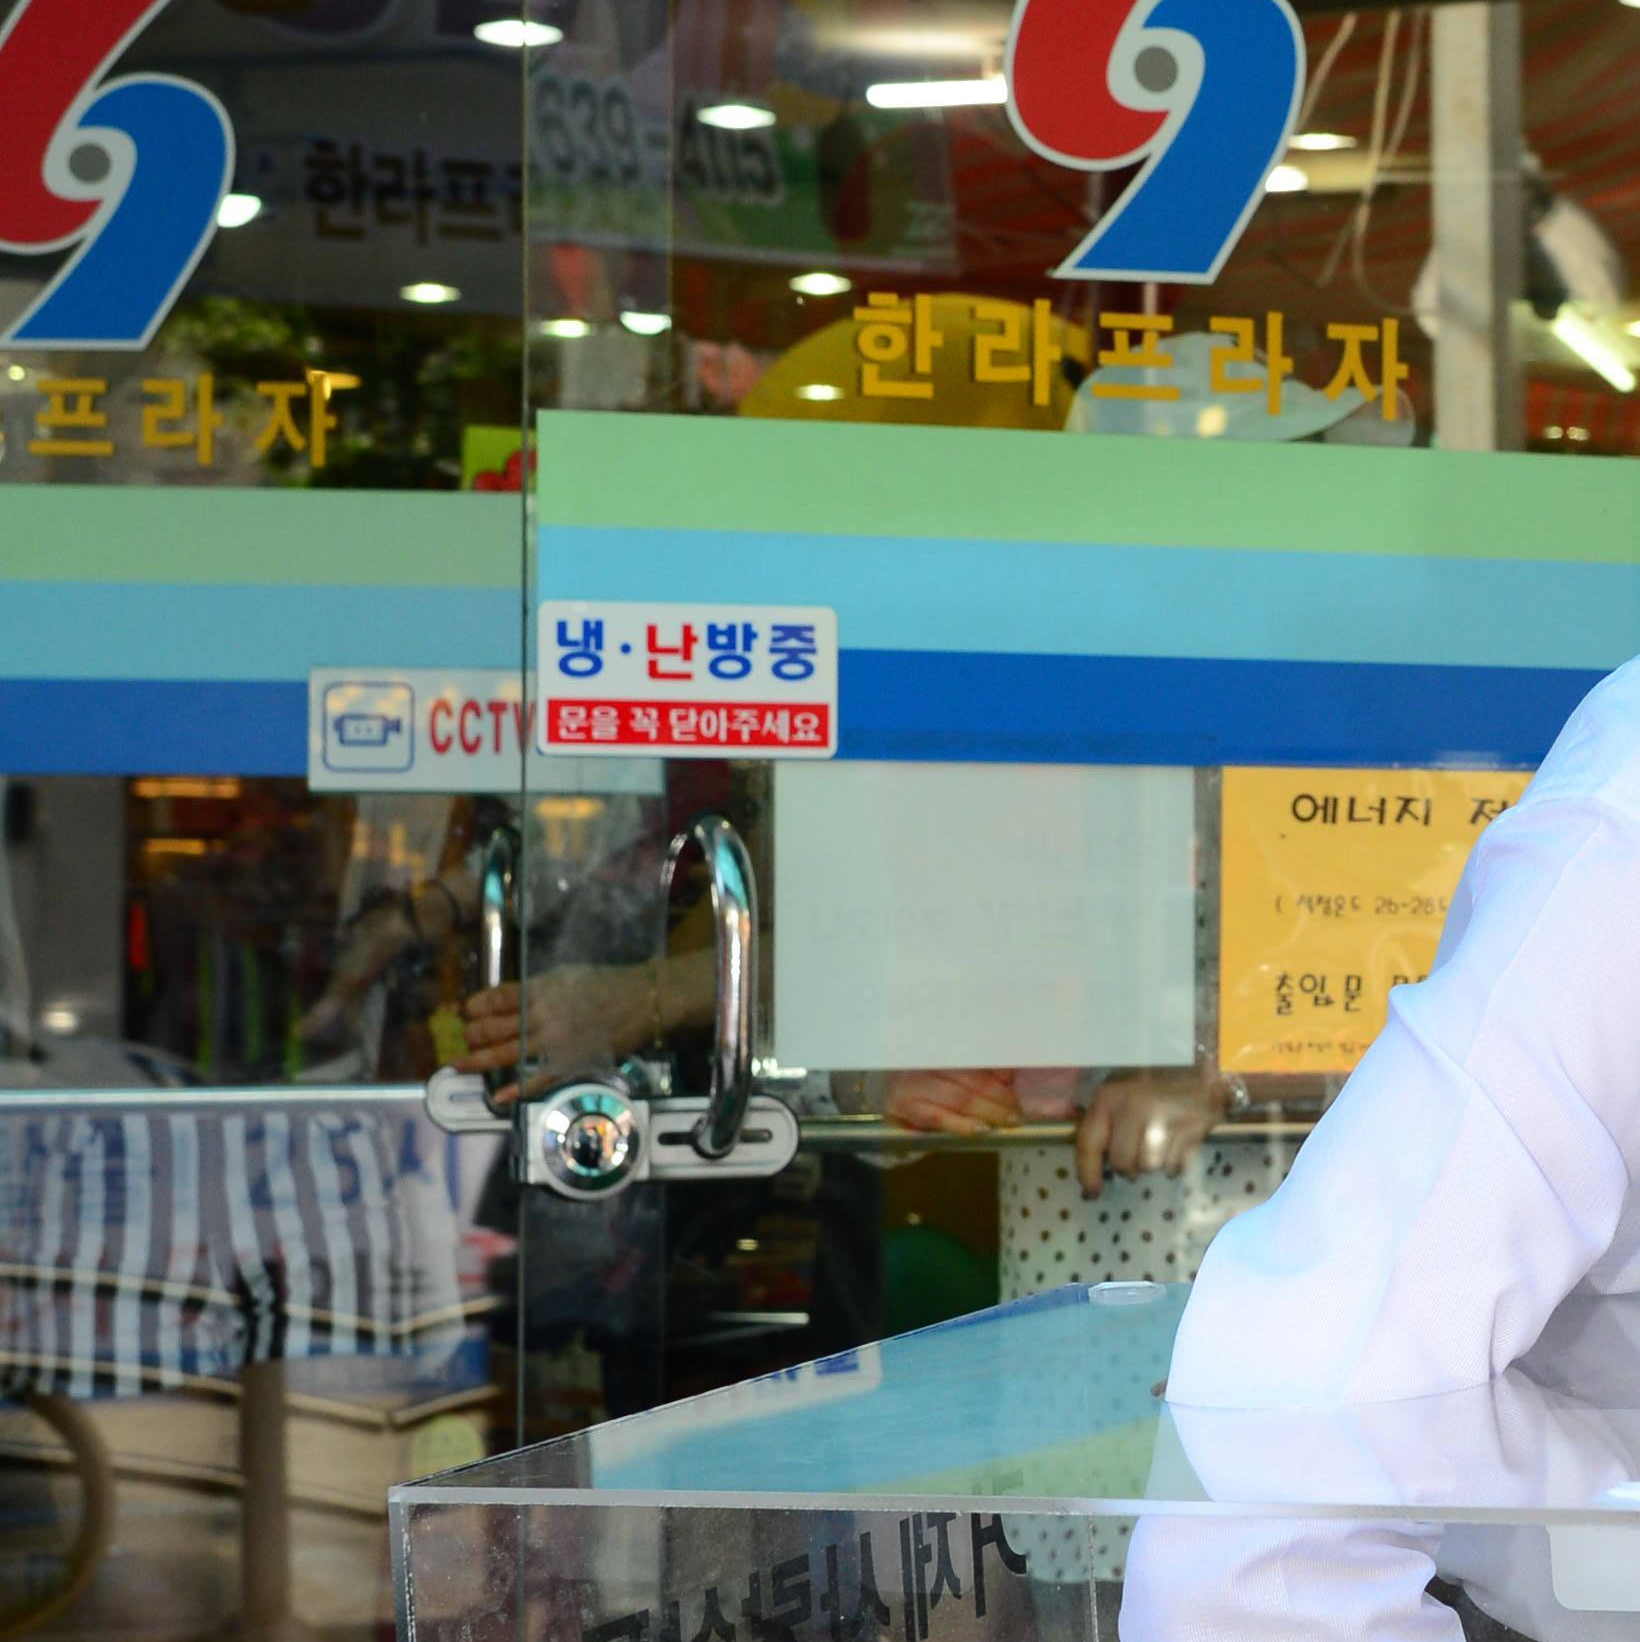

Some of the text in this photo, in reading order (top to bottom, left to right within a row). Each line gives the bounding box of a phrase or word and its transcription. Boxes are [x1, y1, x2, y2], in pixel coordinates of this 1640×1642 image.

[305, 140, 524, 247] 한라프
[853, 291, 1409, 422] 한라프라자
[428, 697, 537, 756] CCTV
[556, 706, 824, 746] 문을 꼭 닫아주세요
[1291, 793, 1433, 827] 에너지
[1274, 971, 1364, 1017] 출입문
